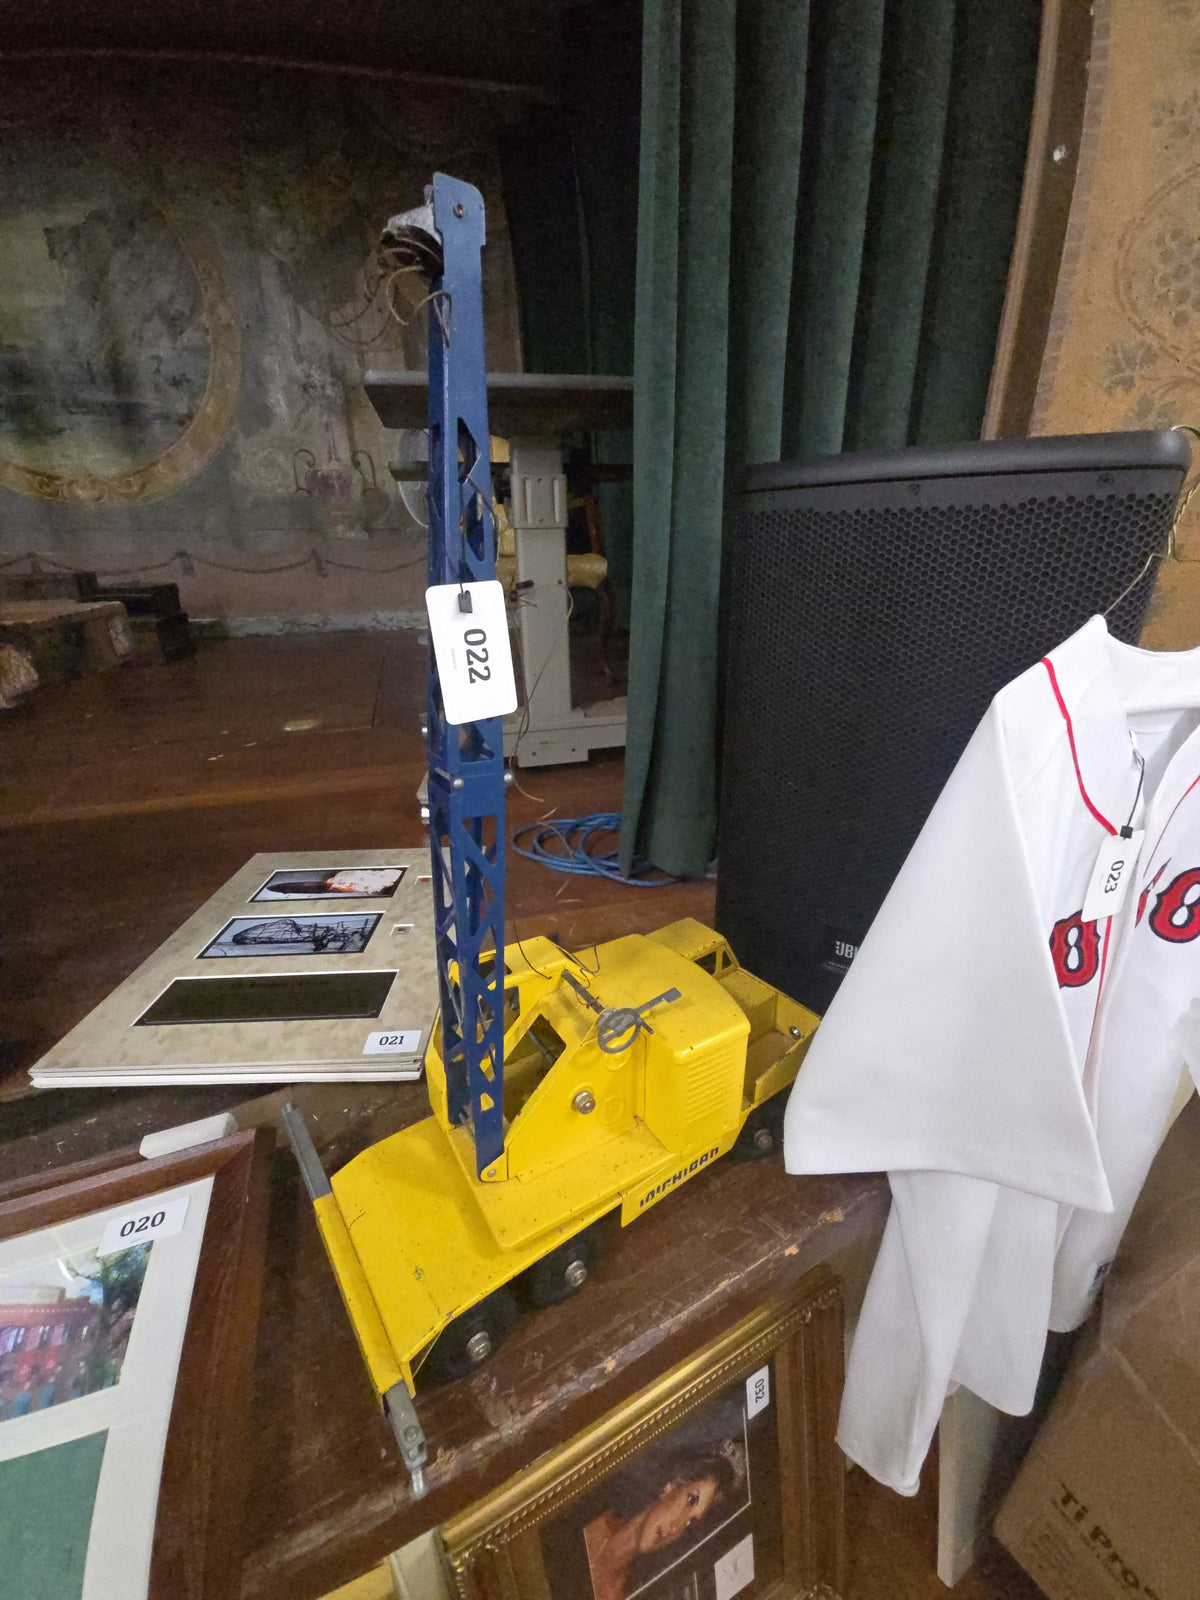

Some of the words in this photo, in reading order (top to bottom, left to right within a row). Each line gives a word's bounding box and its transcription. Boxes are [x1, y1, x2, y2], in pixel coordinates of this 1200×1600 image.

[464, 628, 491, 684] 022
[1104, 860, 1125, 894] 023
[379, 1035, 404, 1046] 021
[120, 1211, 166, 1238] 020
[754, 1378, 765, 1404] 032
